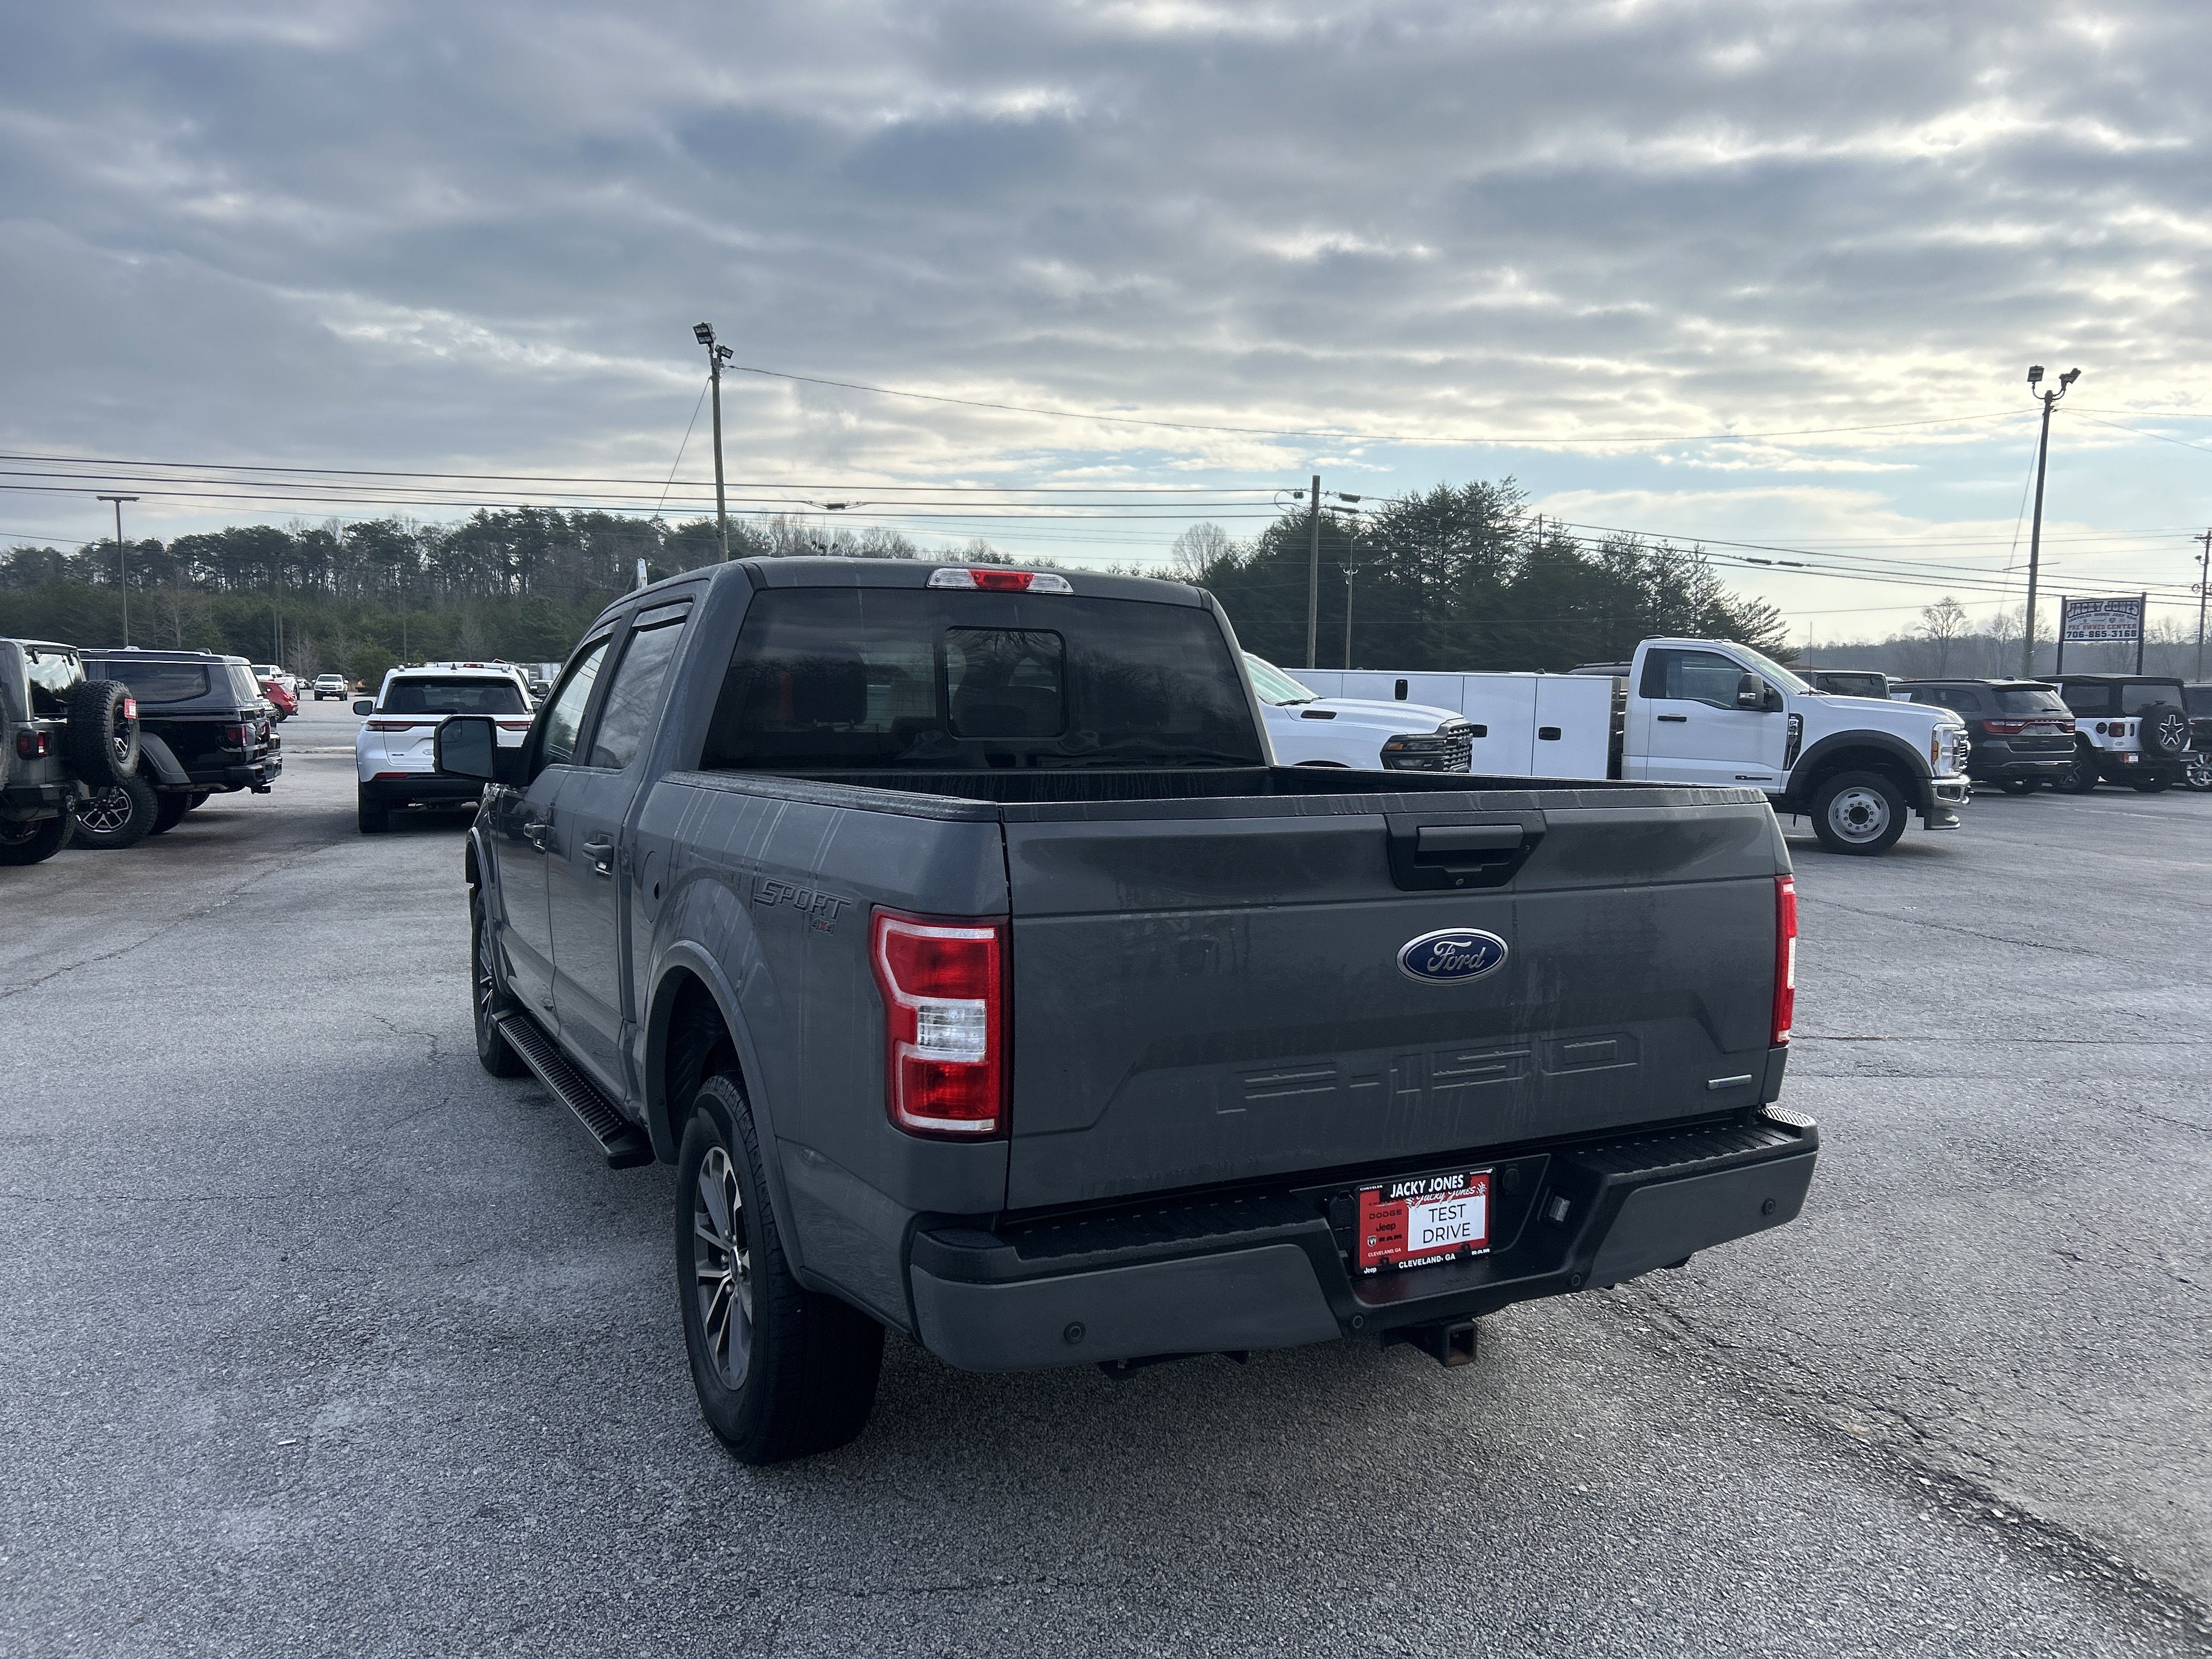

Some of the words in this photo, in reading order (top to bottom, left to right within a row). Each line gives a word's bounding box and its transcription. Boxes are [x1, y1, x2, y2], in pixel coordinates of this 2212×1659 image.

[753, 878, 853, 920] SPORT
[1426, 941, 1486, 972] Ford
[1216, 1031, 1643, 1115] F-150
[1390, 1180, 1426, 1198] JACKY
[1428, 1174, 1464, 1193] JONES
[1415, 1192, 1446, 1207] Jacky
[1447, 1186, 1476, 1201] Jones
[1369, 1209, 1402, 1220] DODGE
[1428, 1204, 1466, 1223] TEST
[1376, 1222, 1396, 1232] Jeep
[1423, 1222, 1471, 1244] DRIVE
[1379, 1234, 1403, 1243] RAM
[1398, 1254, 1443, 1269] CLEVELAND,
